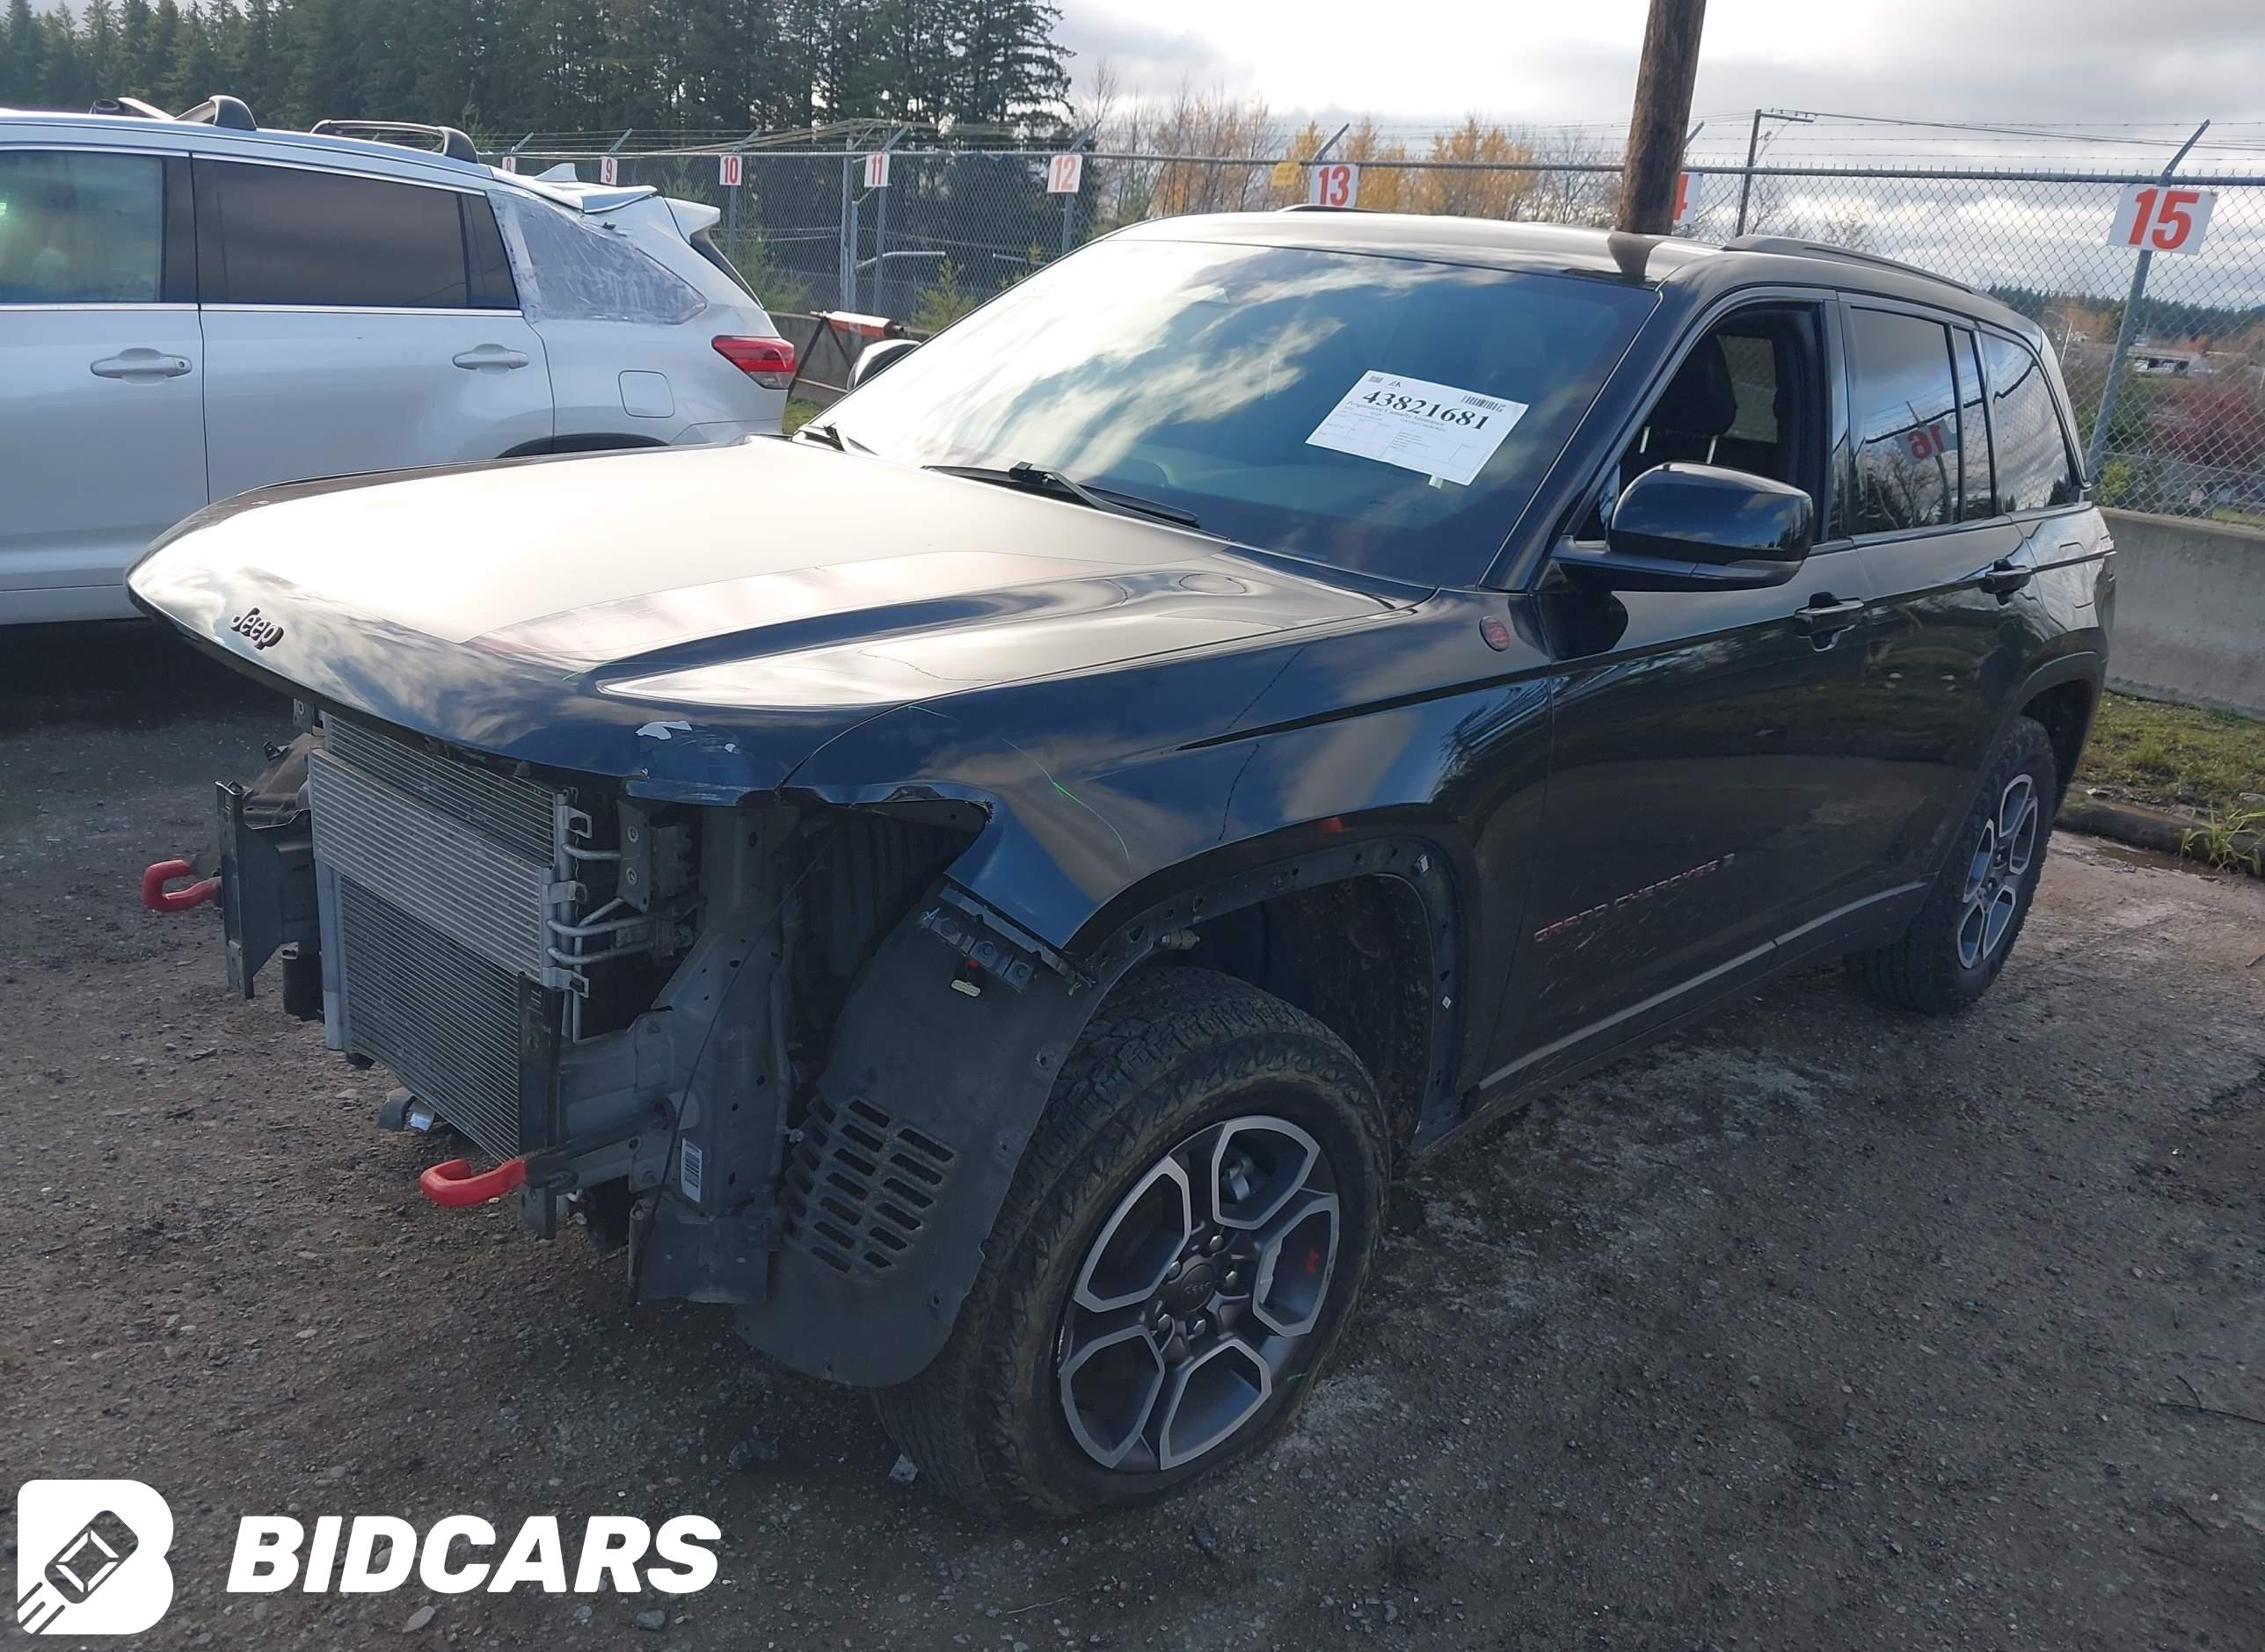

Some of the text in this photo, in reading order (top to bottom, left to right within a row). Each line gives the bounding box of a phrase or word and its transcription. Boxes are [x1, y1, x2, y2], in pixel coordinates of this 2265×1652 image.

[605, 157, 613, 183] 9
[724, 156, 738, 185] 10
[871, 156, 884, 185] 11
[1053, 156, 1076, 191] 12
[1319, 164, 1351, 207] 13
[2129, 188, 2200, 250] 15
[1362, 389, 1490, 431] 43821681
[230, 607, 285, 651] Jeep
